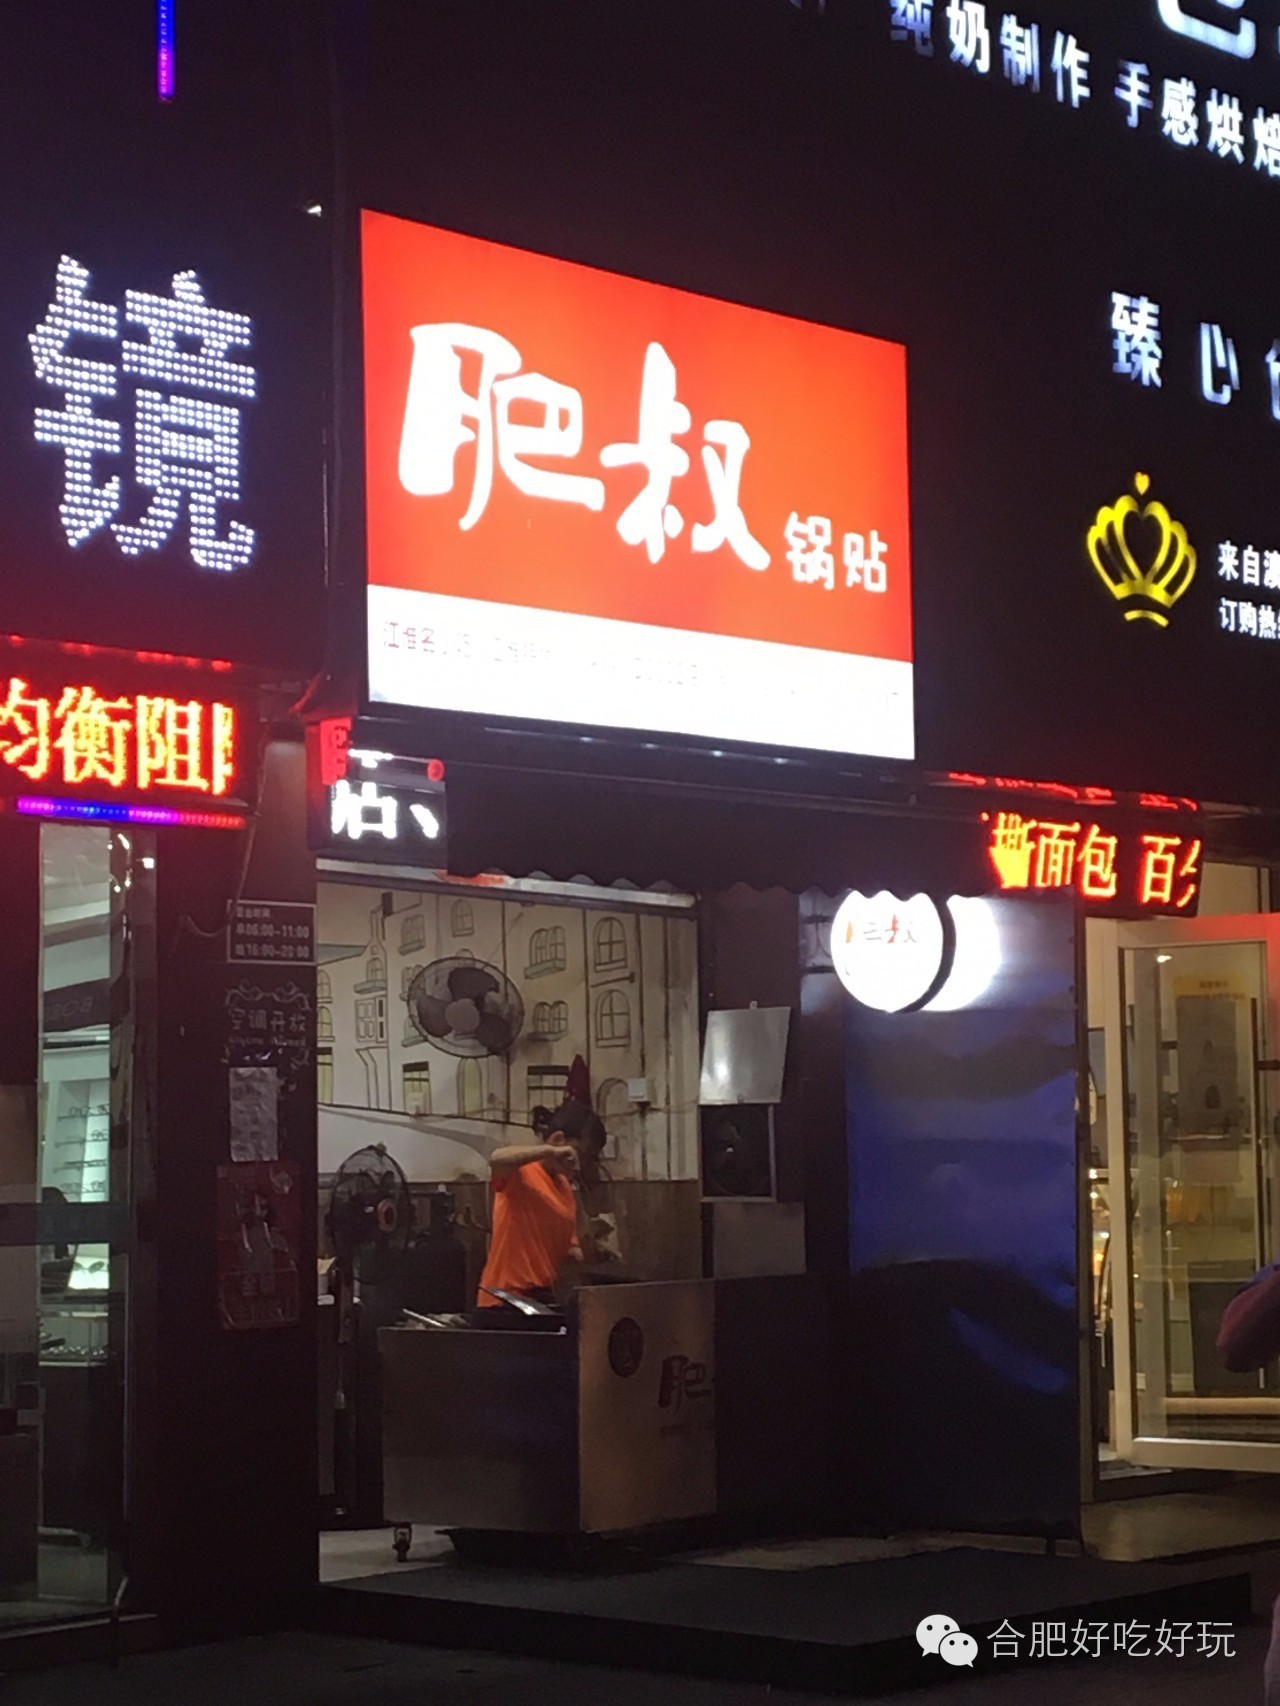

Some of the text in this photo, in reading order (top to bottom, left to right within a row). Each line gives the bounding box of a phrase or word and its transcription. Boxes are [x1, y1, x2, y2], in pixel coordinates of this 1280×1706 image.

[891, 0, 1091, 108] 纯奶制作
[28, 254, 256, 572] 镜
[398, 322, 889, 593] 肥叔 锅贴
[1218, 597, 1280, 640] 订购热
[659, 1354, 712, 1416] 肥
